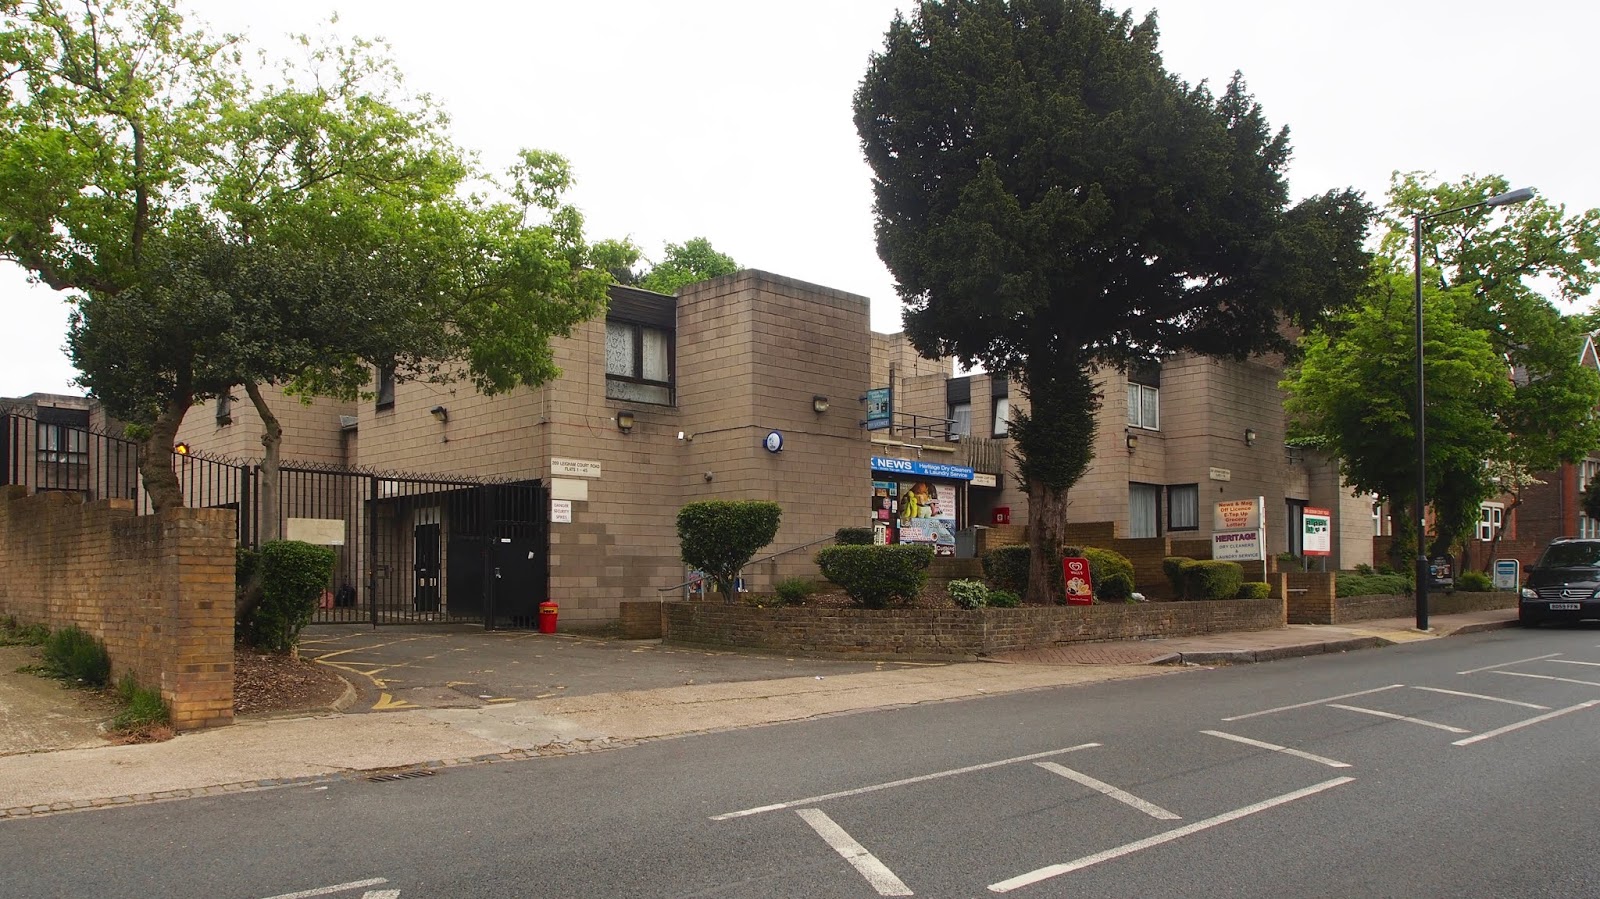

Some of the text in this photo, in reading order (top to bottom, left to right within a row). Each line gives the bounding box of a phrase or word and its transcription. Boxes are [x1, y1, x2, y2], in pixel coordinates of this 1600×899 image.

[877, 458, 912, 470] NEWS
[918, 462, 941, 473] Heritage
[941, 465, 951, 473] Dry
[950, 466, 972, 474] Cleaners
[929, 469, 949, 478] Laundry
[1215, 532, 1256, 542] HERITAGE
